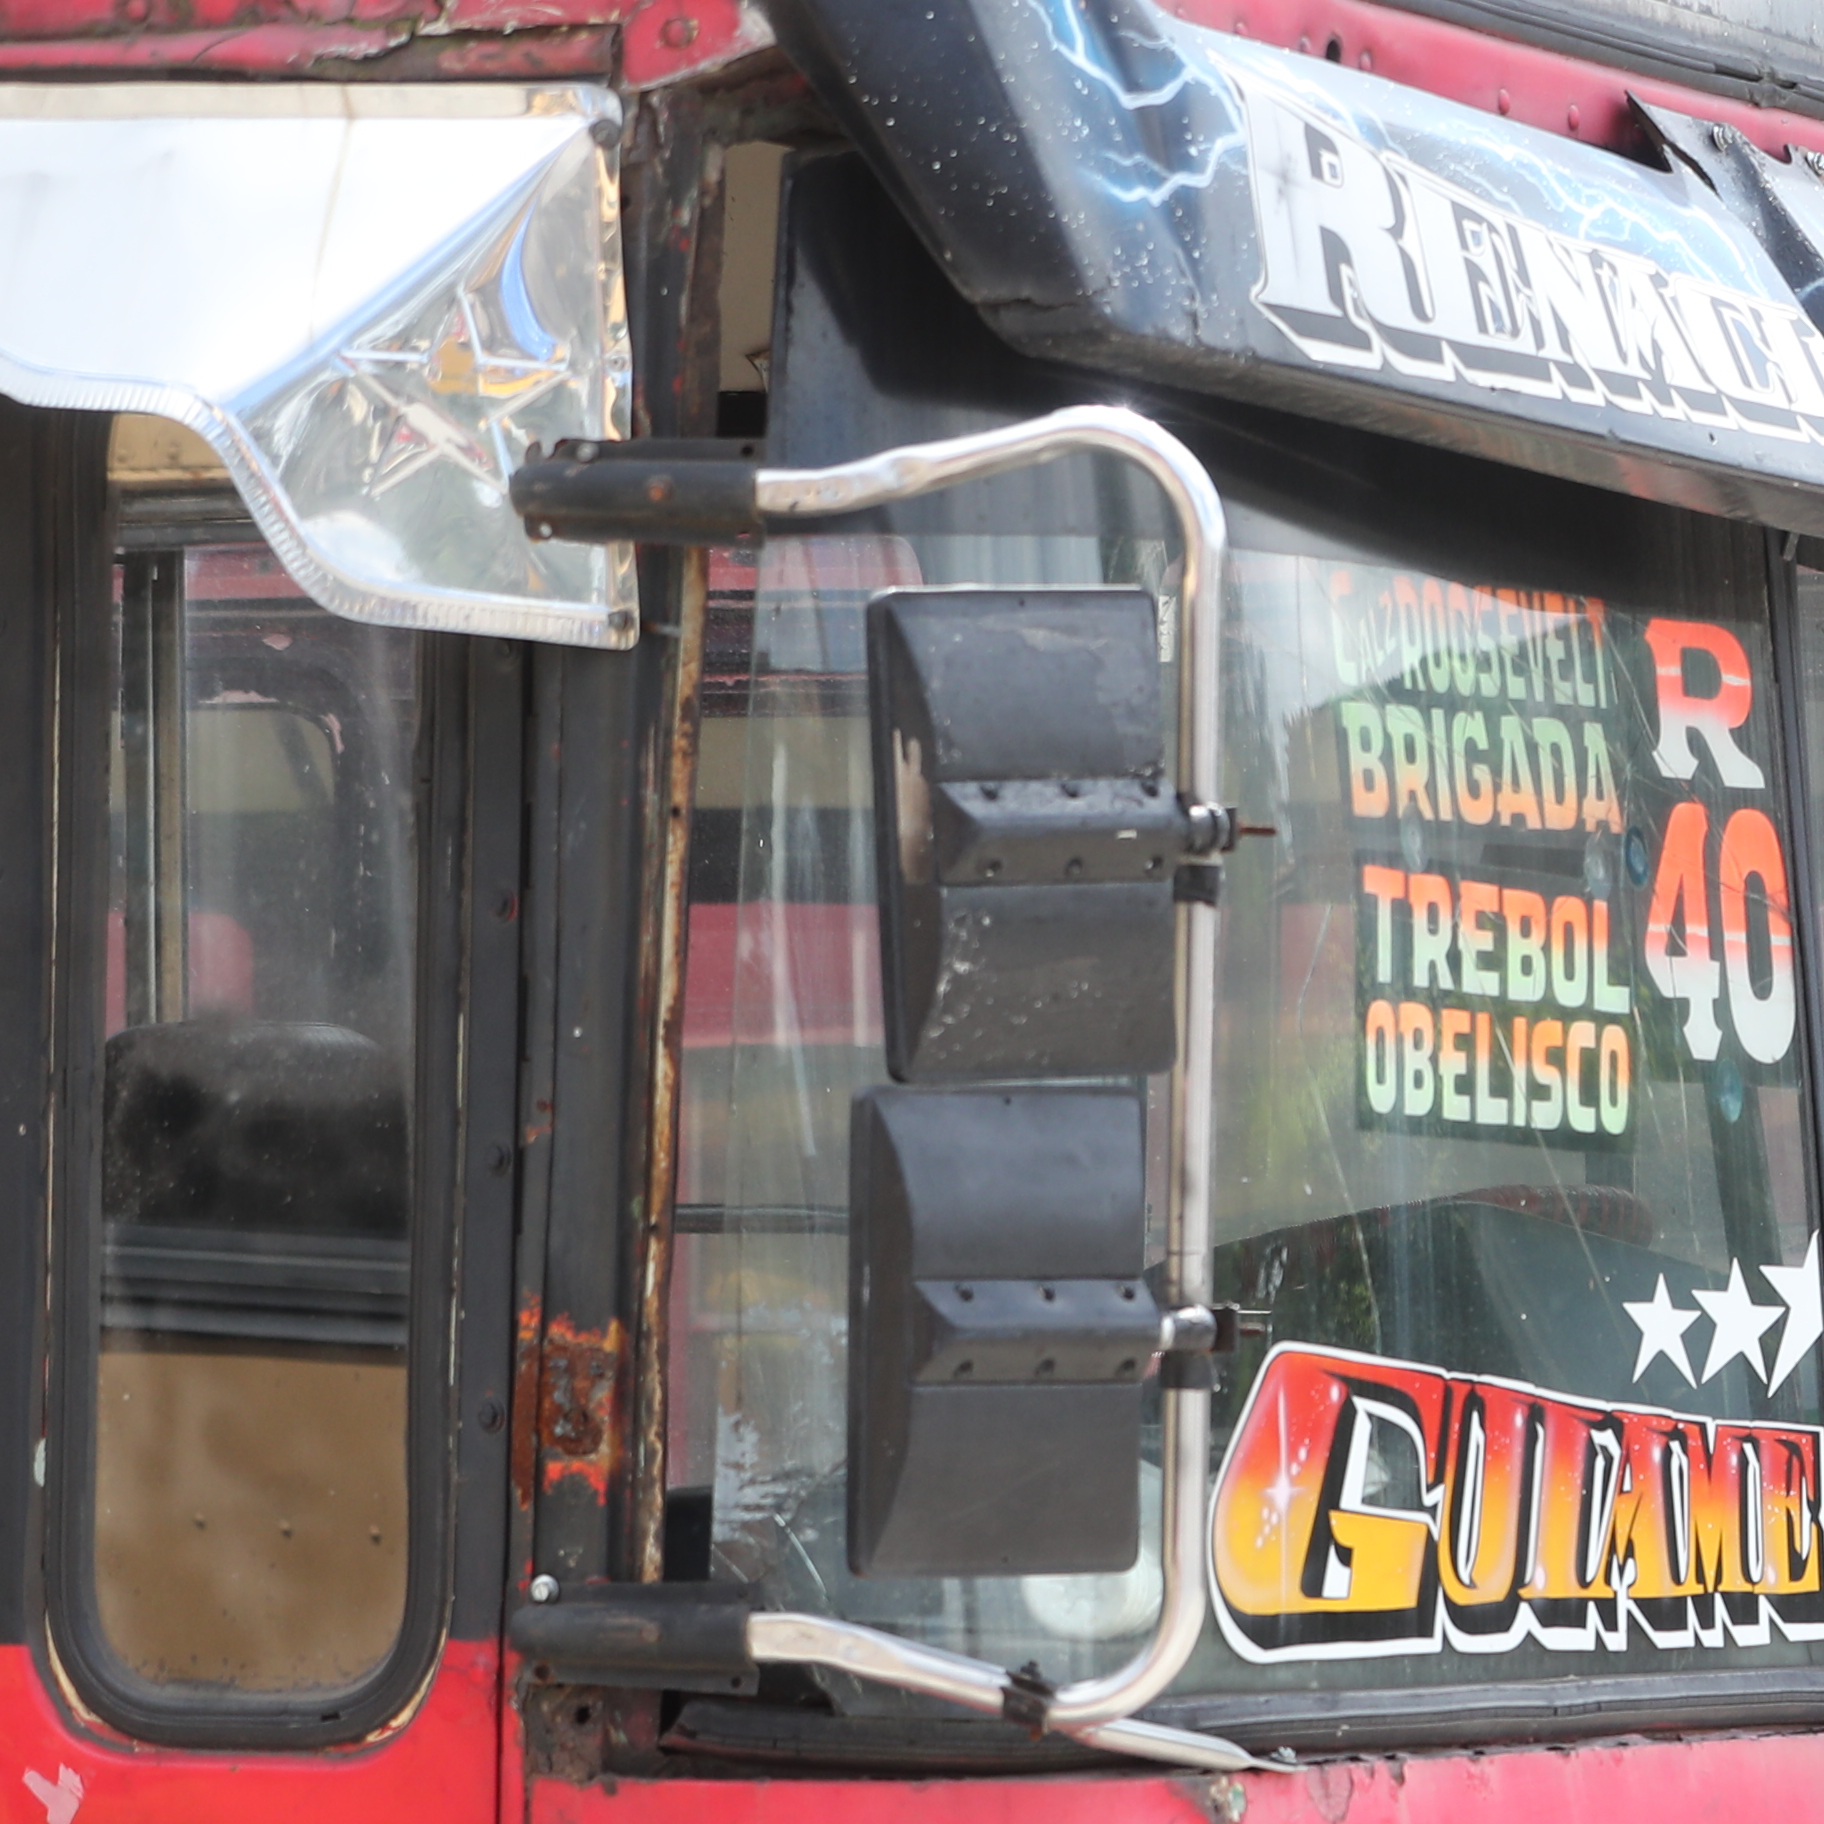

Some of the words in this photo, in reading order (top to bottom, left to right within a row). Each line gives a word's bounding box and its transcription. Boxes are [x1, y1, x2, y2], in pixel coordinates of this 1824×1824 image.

[1393, 575, 1608, 709] ROOSEVELT
[1644, 617, 1766, 789] R
[1341, 701, 1624, 834] BRIGADA
[1363, 864, 1630, 1014] TREBOL
[1644, 801, 1797, 1064] 40
[1365, 999, 1630, 1136] OBELISCO
